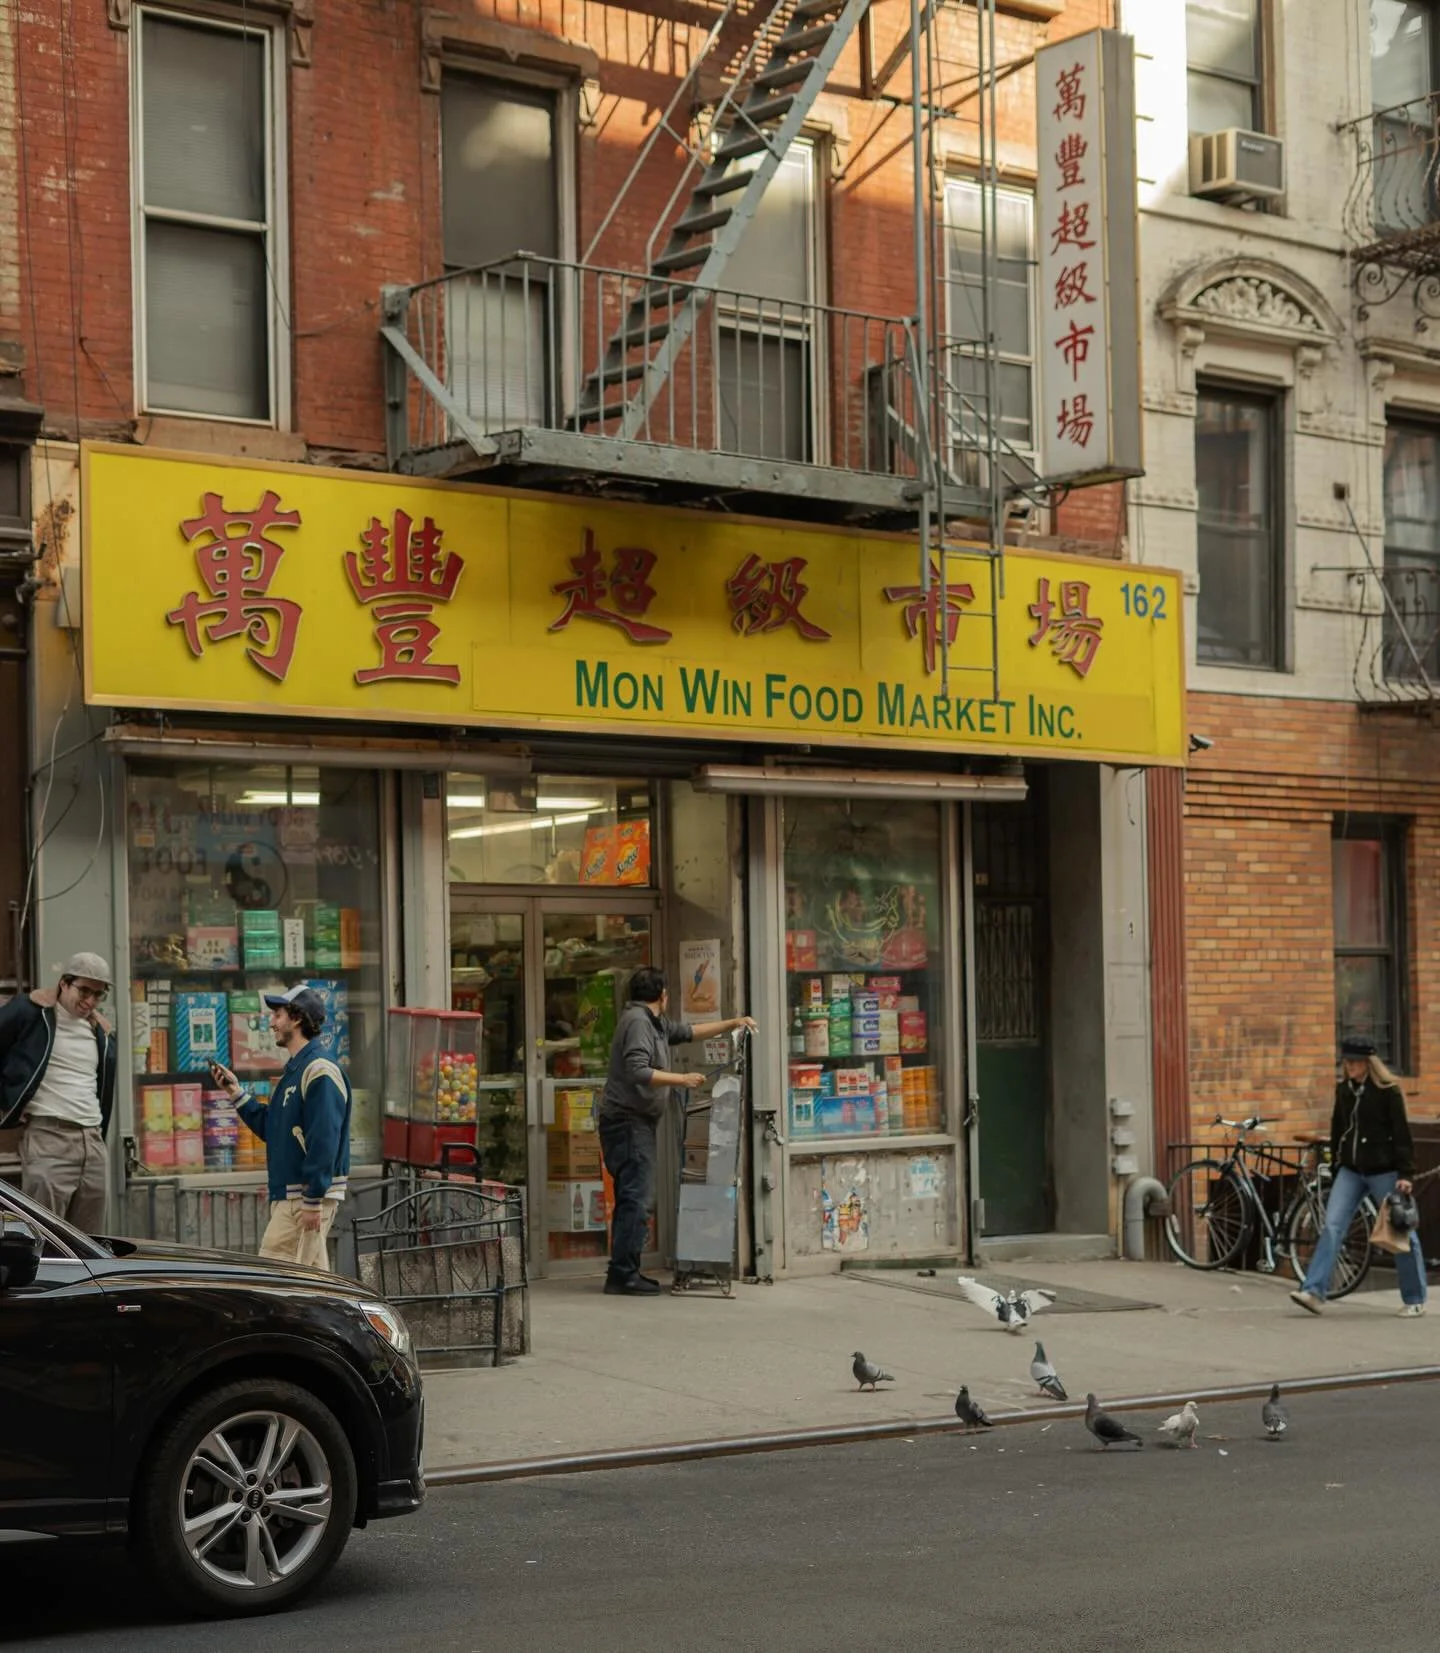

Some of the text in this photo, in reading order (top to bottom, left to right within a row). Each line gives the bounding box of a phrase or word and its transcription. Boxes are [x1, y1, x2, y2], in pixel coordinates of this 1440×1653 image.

[1052, 63, 1097, 447] 萬豐超級市場
[166, 490, 1104, 685] 萬豐超級市場
[1120, 581, 1167, 619] 162
[765, 673, 864, 723] FOOD
[878, 682, 1016, 735] MARKET
